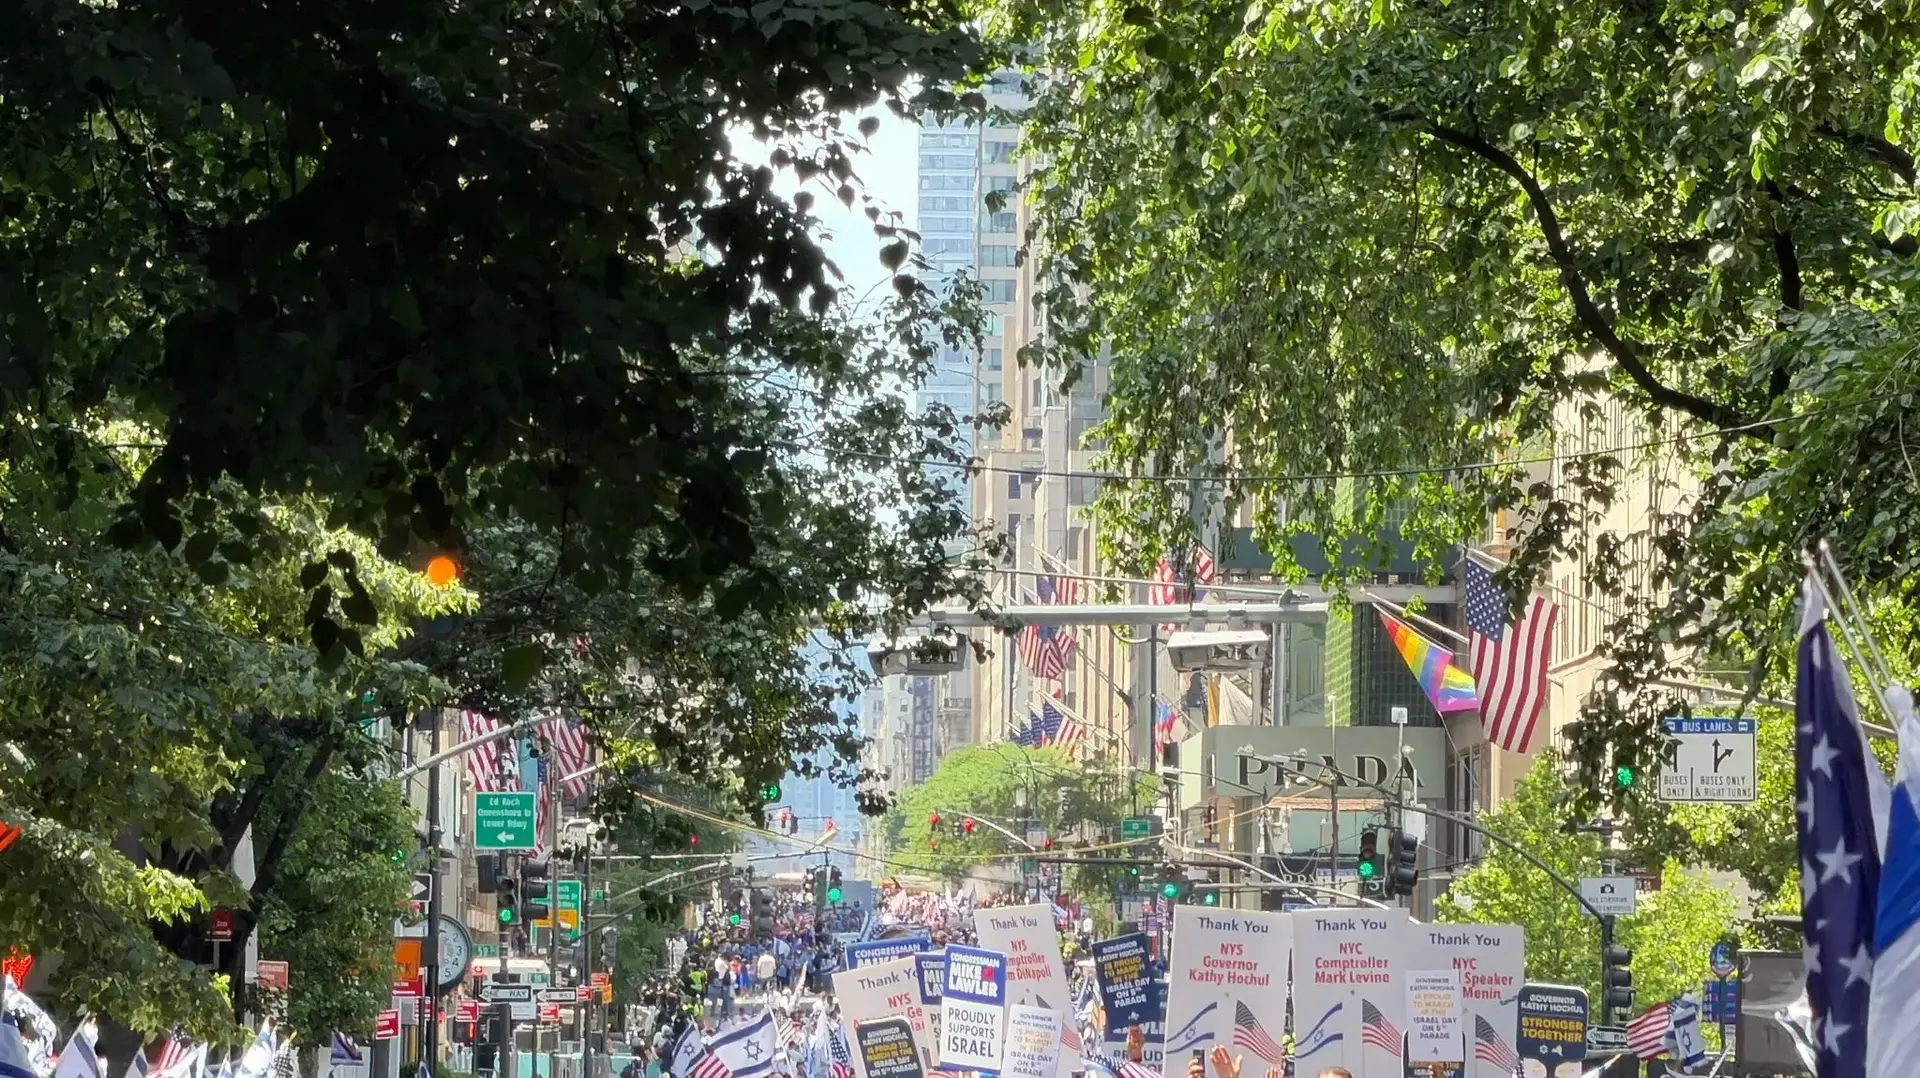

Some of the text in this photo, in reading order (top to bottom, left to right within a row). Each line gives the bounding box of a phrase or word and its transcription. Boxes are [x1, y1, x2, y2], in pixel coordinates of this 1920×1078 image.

[1682, 721, 1732, 732] BUS LANES
[1238, 754, 1425, 788] PRADA
[1664, 775, 1688, 785] BUSES
[1701, 776, 1746, 786] BUSES ONLY
[1667, 787, 1685, 797] ONLY
[489, 797, 520, 806] Ed Koch
[990, 915, 1037, 930] Thank You
[1196, 916, 1269, 933] Thank You
[1315, 918, 1387, 931] Thank You
[1010, 939, 1027, 952] NYS
[1429, 932, 1500, 946] Thank You
[456, 945, 462, 956] 3
[855, 943, 921, 958] CONGRESSMAN
[1220, 943, 1243, 956] NYS
[1339, 942, 1363, 955] NYC
[452, 957, 459, 967] 4
[950, 952, 999, 969] CONGRESSMAN
[1008, 952, 1045, 966] mptroller
[1203, 955, 1258, 971] Governor
[1315, 956, 1389, 972] Comptroller
[1452, 957, 1477, 970] NYC
[444, 968, 452, 978] 5
[951, 962, 982, 980] MIKE
[1016, 965, 1051, 981] DiNapoli
[1189, 968, 1269, 986] Kathy Hochul
[1315, 970, 1390, 984] Mark Levine
[858, 971, 900, 990] Thank
[1106, 976, 1150, 994] ISRAEL DAY
[1464, 971, 1513, 987] Speaker
[509, 989, 527, 998] WAY
[948, 976, 998, 998] LAWLER
[1462, 986, 1501, 1000] Menin
[887, 992, 912, 1009] NYS
[1116, 990, 1129, 999] ON
[1529, 993, 1576, 1004] GOVERNOR
[1521, 1002, 1584, 1014] KATHY HOCHUL
[948, 1007, 996, 1025] PROUDLY
[1413, 1016, 1457, 1024] ISRAEL DAY
[948, 1022, 995, 1040] SUPPORTS
[1521, 1017, 1584, 1031] STRONGER
[1420, 1032, 1450, 1040] PARADE
[1522, 1028, 1583, 1042] TOGETHER
[947, 1035, 995, 1058] ISRAEL
[1010, 1050, 1053, 1063] ISRAEL DAY
[1012, 1066, 1043, 1077] PARADE
